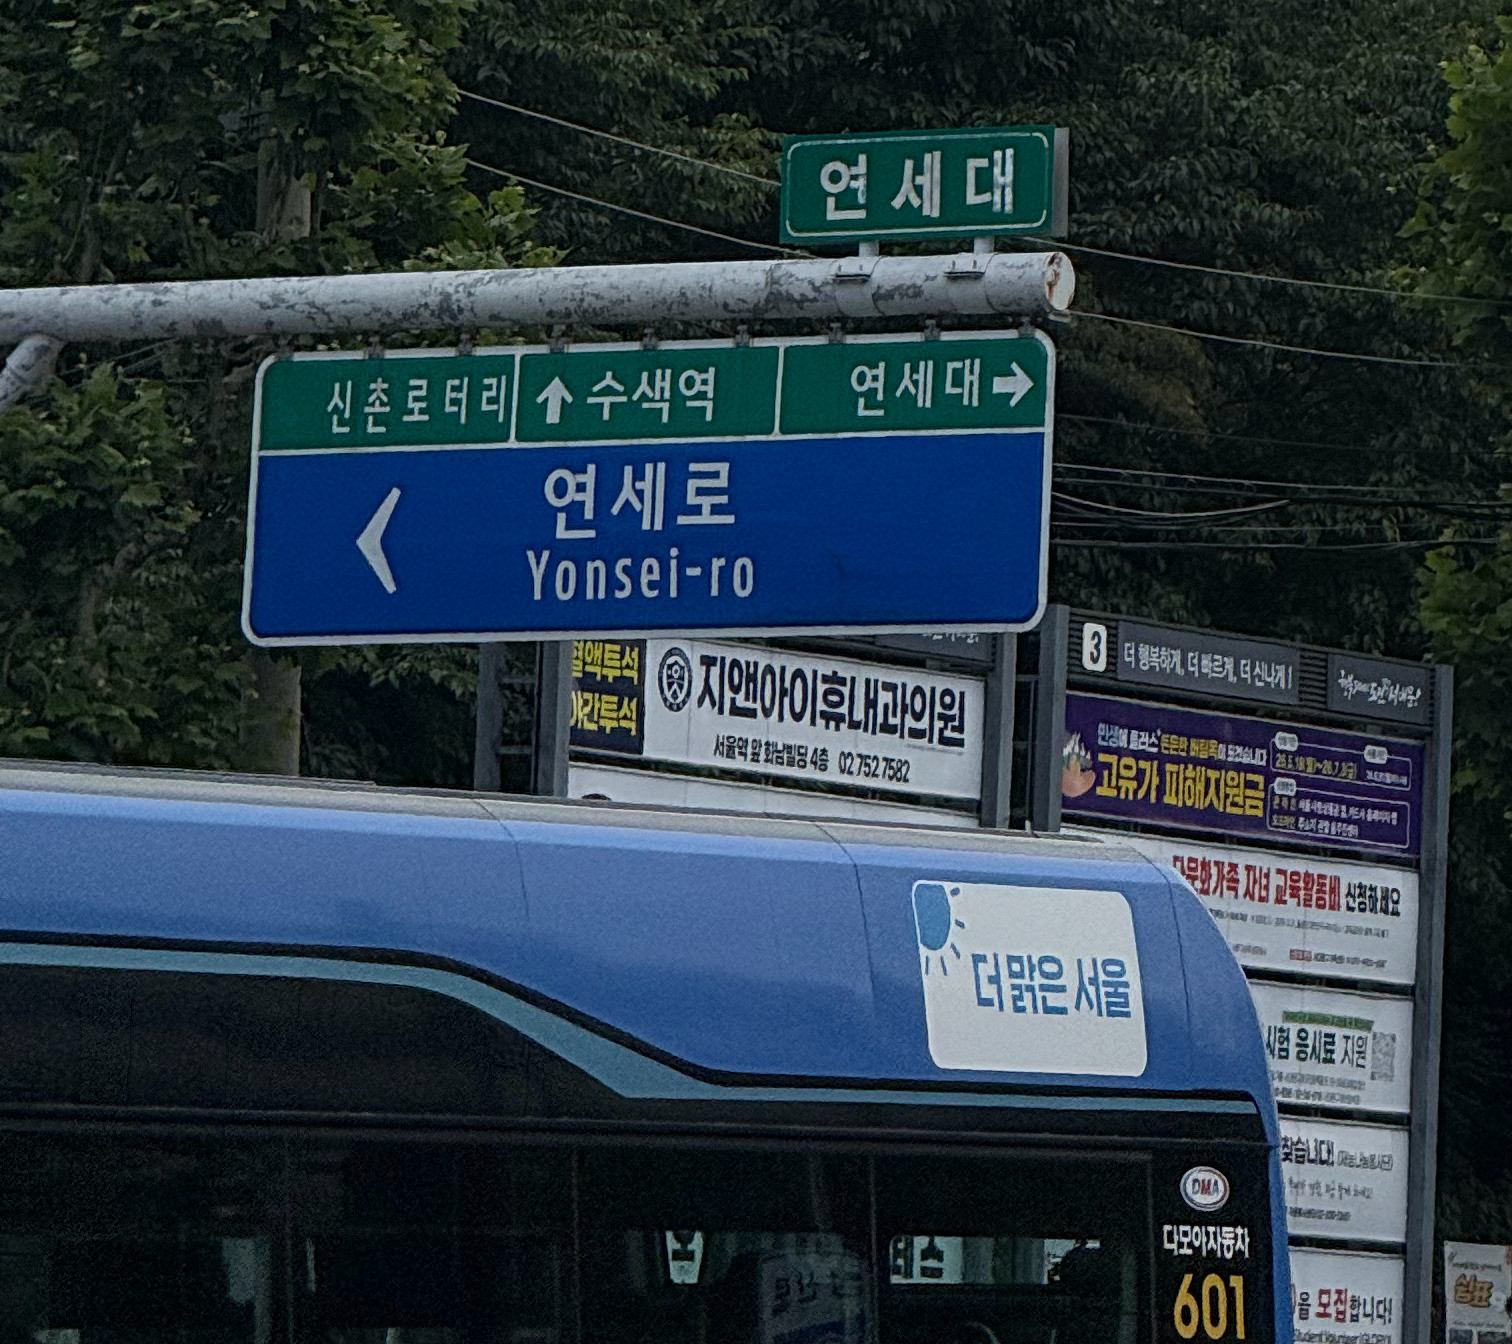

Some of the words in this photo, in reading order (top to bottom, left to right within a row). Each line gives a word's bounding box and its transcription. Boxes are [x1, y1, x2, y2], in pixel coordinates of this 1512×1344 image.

[819, 146, 1016, 223] 연세대
[326, 373, 508, 436] 신촌로터리
[586, 365, 717, 424] 수색역
[850, 359, 983, 419] 연세대
[543, 460, 736, 541] 연세로
[527, 548, 756, 602] Yonsei-ro
[1088, 628, 1103, 666] 3
[1123, 641, 1135, 668] 더
[1138, 642, 1185, 676] 행복하게,
[1187, 651, 1199, 677] 더
[1240, 658, 1251, 684] 더
[697, 654, 966, 749] 지앤아이휴내과의원
[713, 733, 748, 762] 서울역
[809, 746, 829, 772] 4층
[838, 750, 854, 776] 02
[856, 752, 879, 779] 752
[1095, 751, 1159, 803] 고유가
[1164, 761, 1265, 818] 피해지원금
[1243, 863, 1270, 903] 자녀
[1274, 867, 1341, 912] 교육활동비
[1345, 881, 1401, 918] 신청하세요
[1075, 955, 1132, 1020] 서울
[1265, 1025, 1290, 1061] 시험
[1295, 1027, 1336, 1066] 응시료
[1340, 1034, 1369, 1069] 지원
[1162, 1224, 1250, 1260] 다모아자동차
[1172, 1272, 1245, 1340] 601
[1315, 1287, 1393, 1325] 모집합니다!
